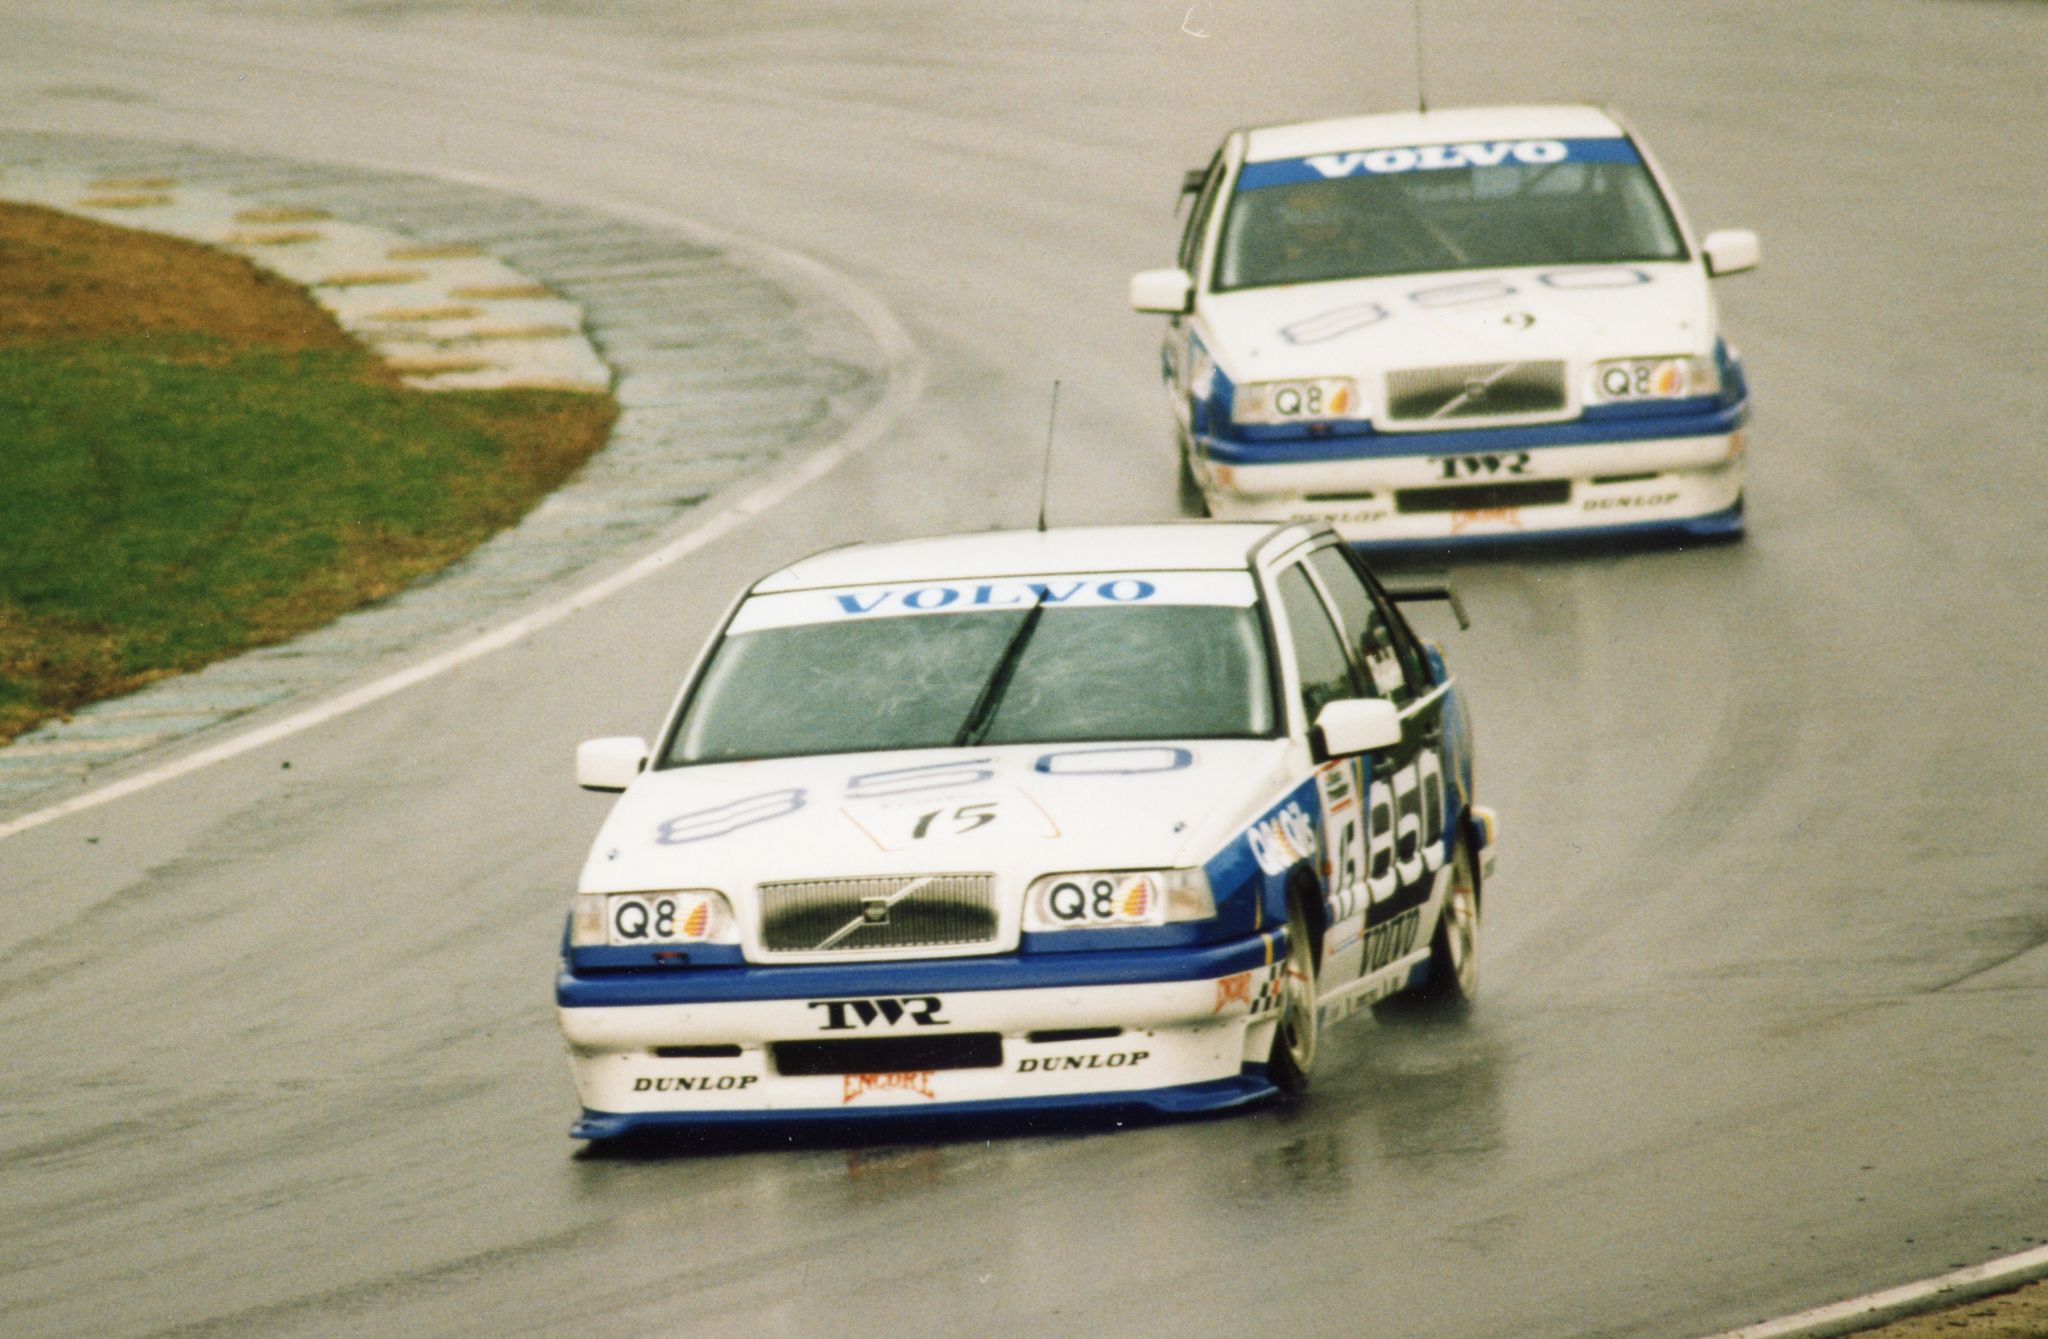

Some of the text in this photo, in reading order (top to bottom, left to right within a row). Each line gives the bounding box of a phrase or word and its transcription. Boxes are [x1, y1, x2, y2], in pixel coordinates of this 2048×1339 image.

[1304, 141, 1567, 178] VOLVO
[1427, 452, 1531, 479] TWR
[1583, 493, 1681, 512] DUNLOP
[834, 578, 1157, 616] VOLVO
[911, 801, 999, 840] 15
[1050, 878, 1115, 921] Q8
[614, 899, 676, 940] Q8
[807, 995, 951, 1031] TWR
[1018, 1050, 1151, 1074] DUNLOP
[633, 1074, 758, 1093] DUNLOP
